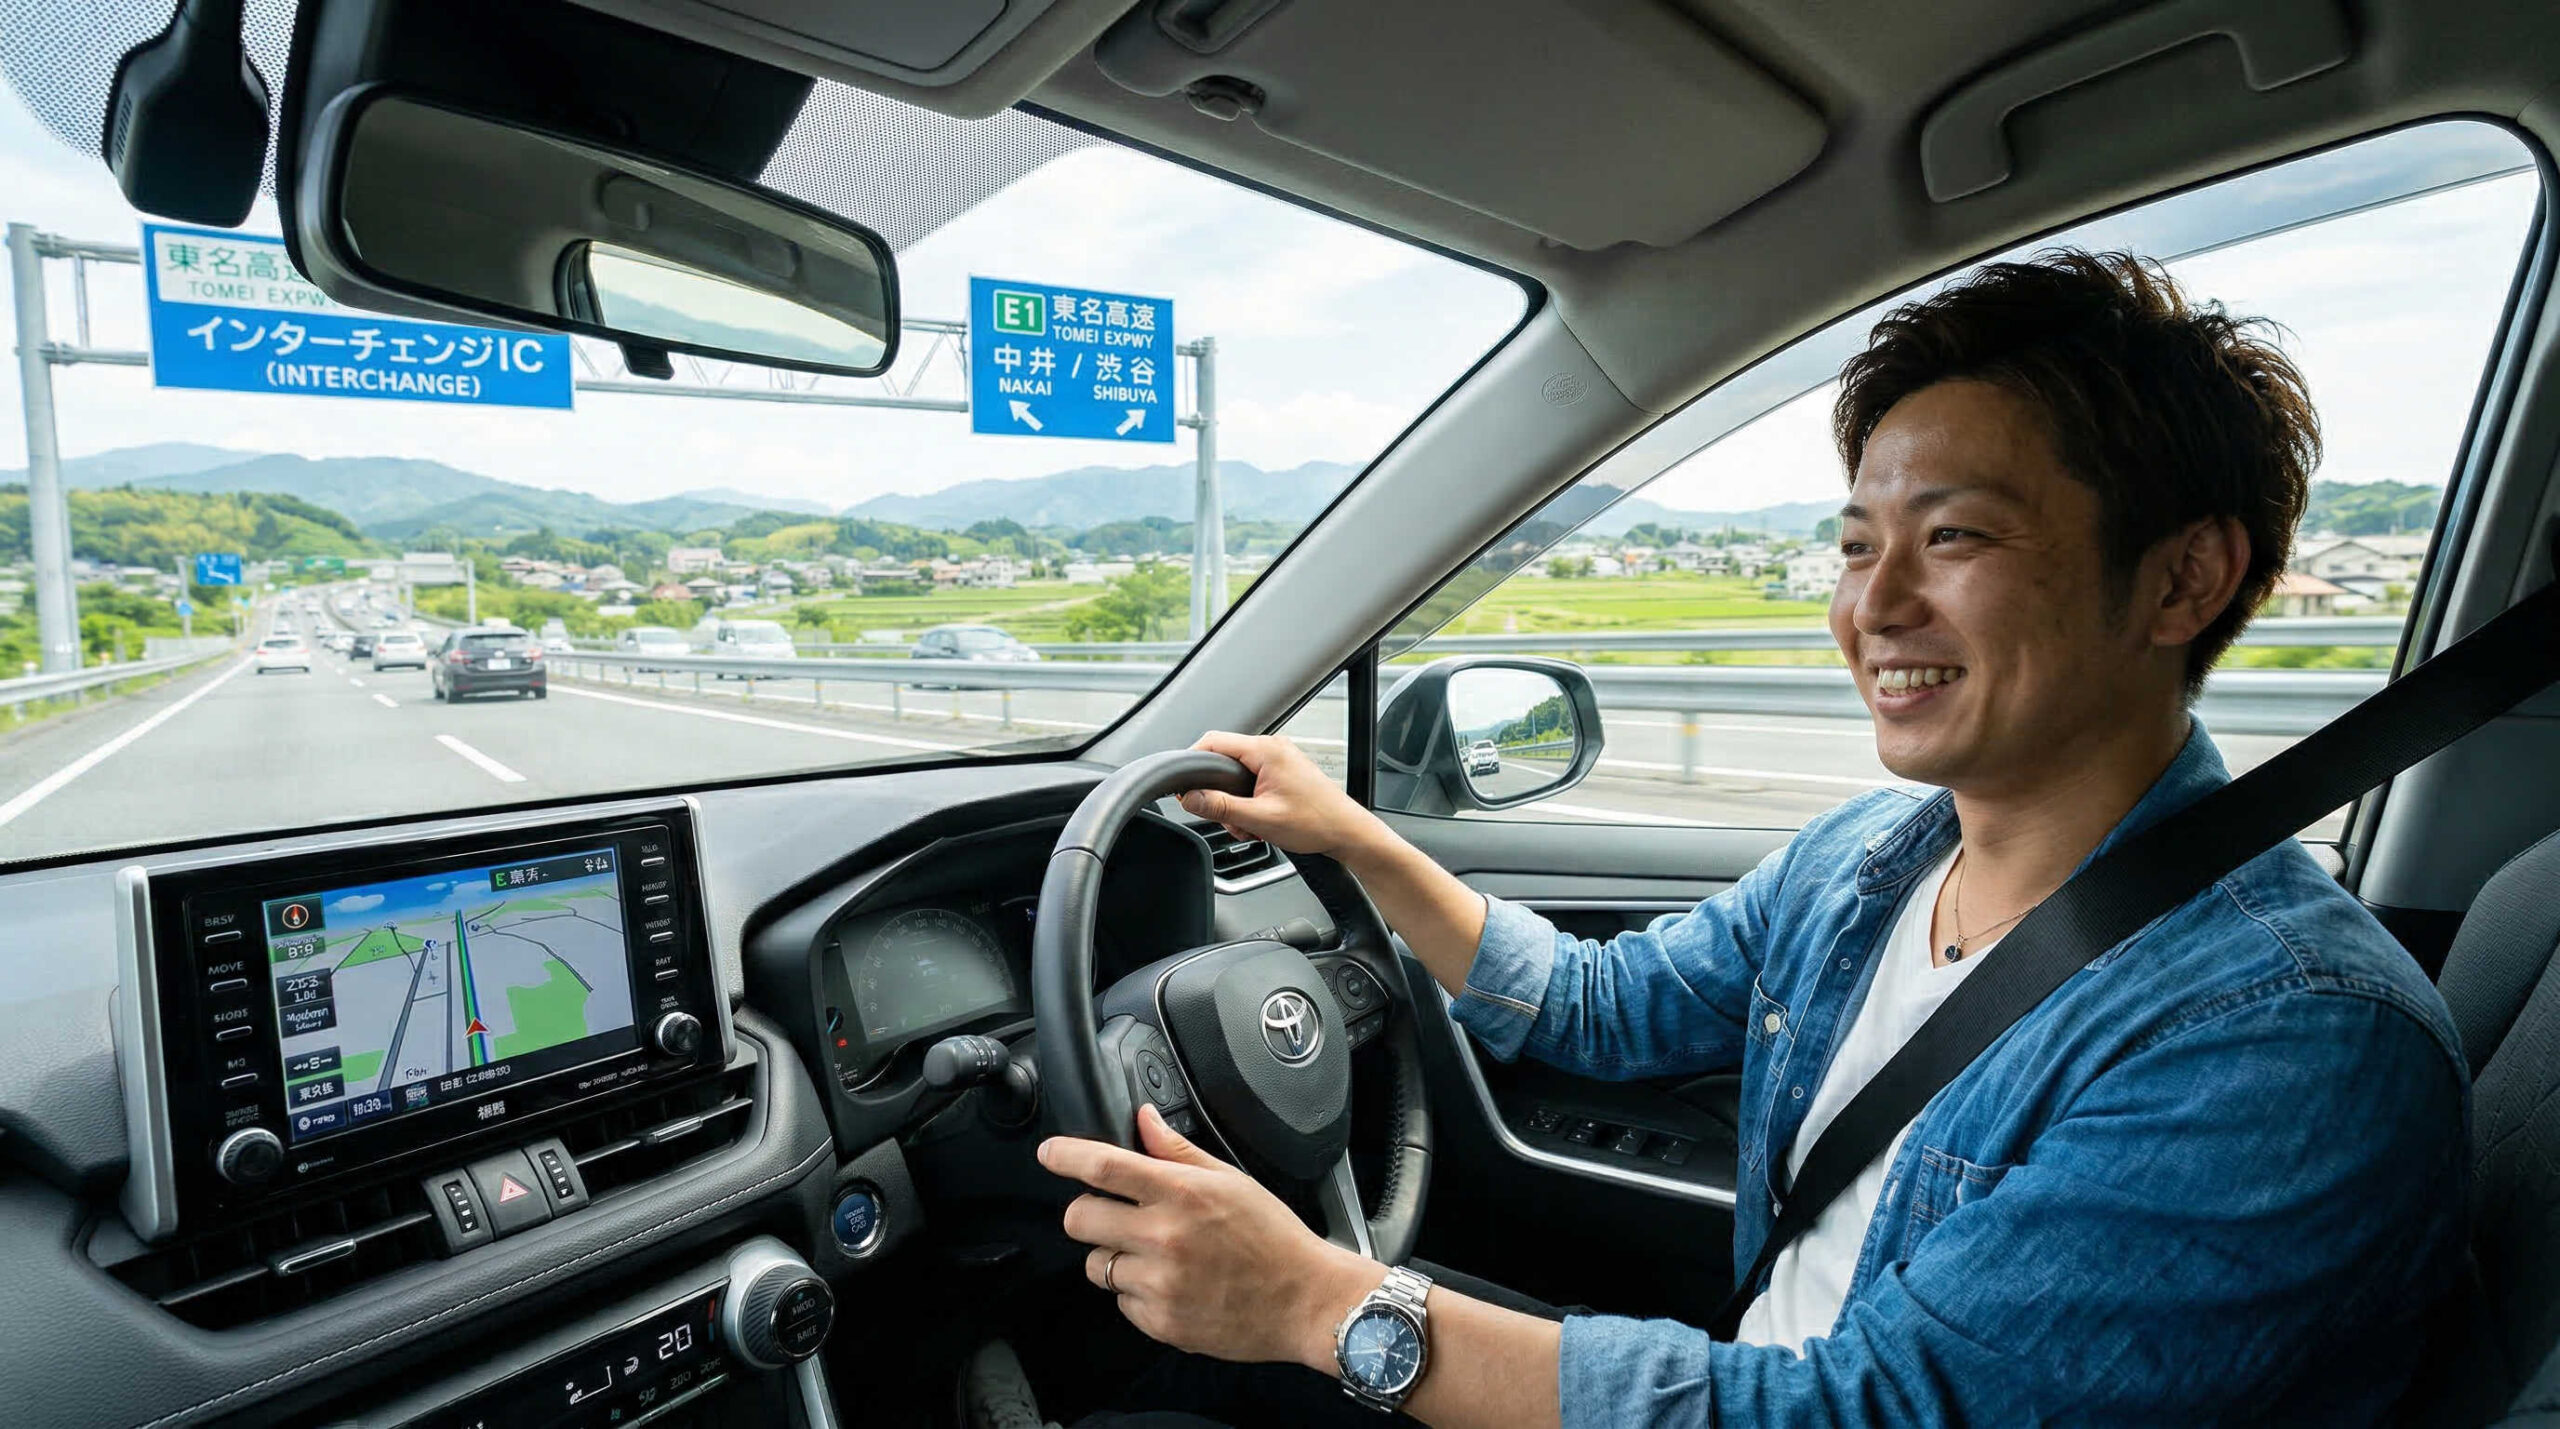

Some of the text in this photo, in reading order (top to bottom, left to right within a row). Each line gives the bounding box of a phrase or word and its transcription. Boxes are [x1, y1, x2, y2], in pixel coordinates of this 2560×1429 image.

[188, 280, 338, 308] TOMEI EXPW
[1004, 297, 1035, 328] E1
[1052, 293, 1156, 331] 東名高速
[187, 315, 544, 373] インターチェンジIC
[1052, 325, 1154, 350] TOMEI EXPWY
[265, 360, 481, 398] (INTERCHANGE)
[993, 342, 1057, 378] 中井
[1096, 352, 1156, 387] 渋谷
[999, 377, 1052, 396] NAKAI
[1093, 384, 1158, 404] SHIBUYA
[208, 960, 245, 975] MOVE
[658, 1323, 693, 1360] 20
